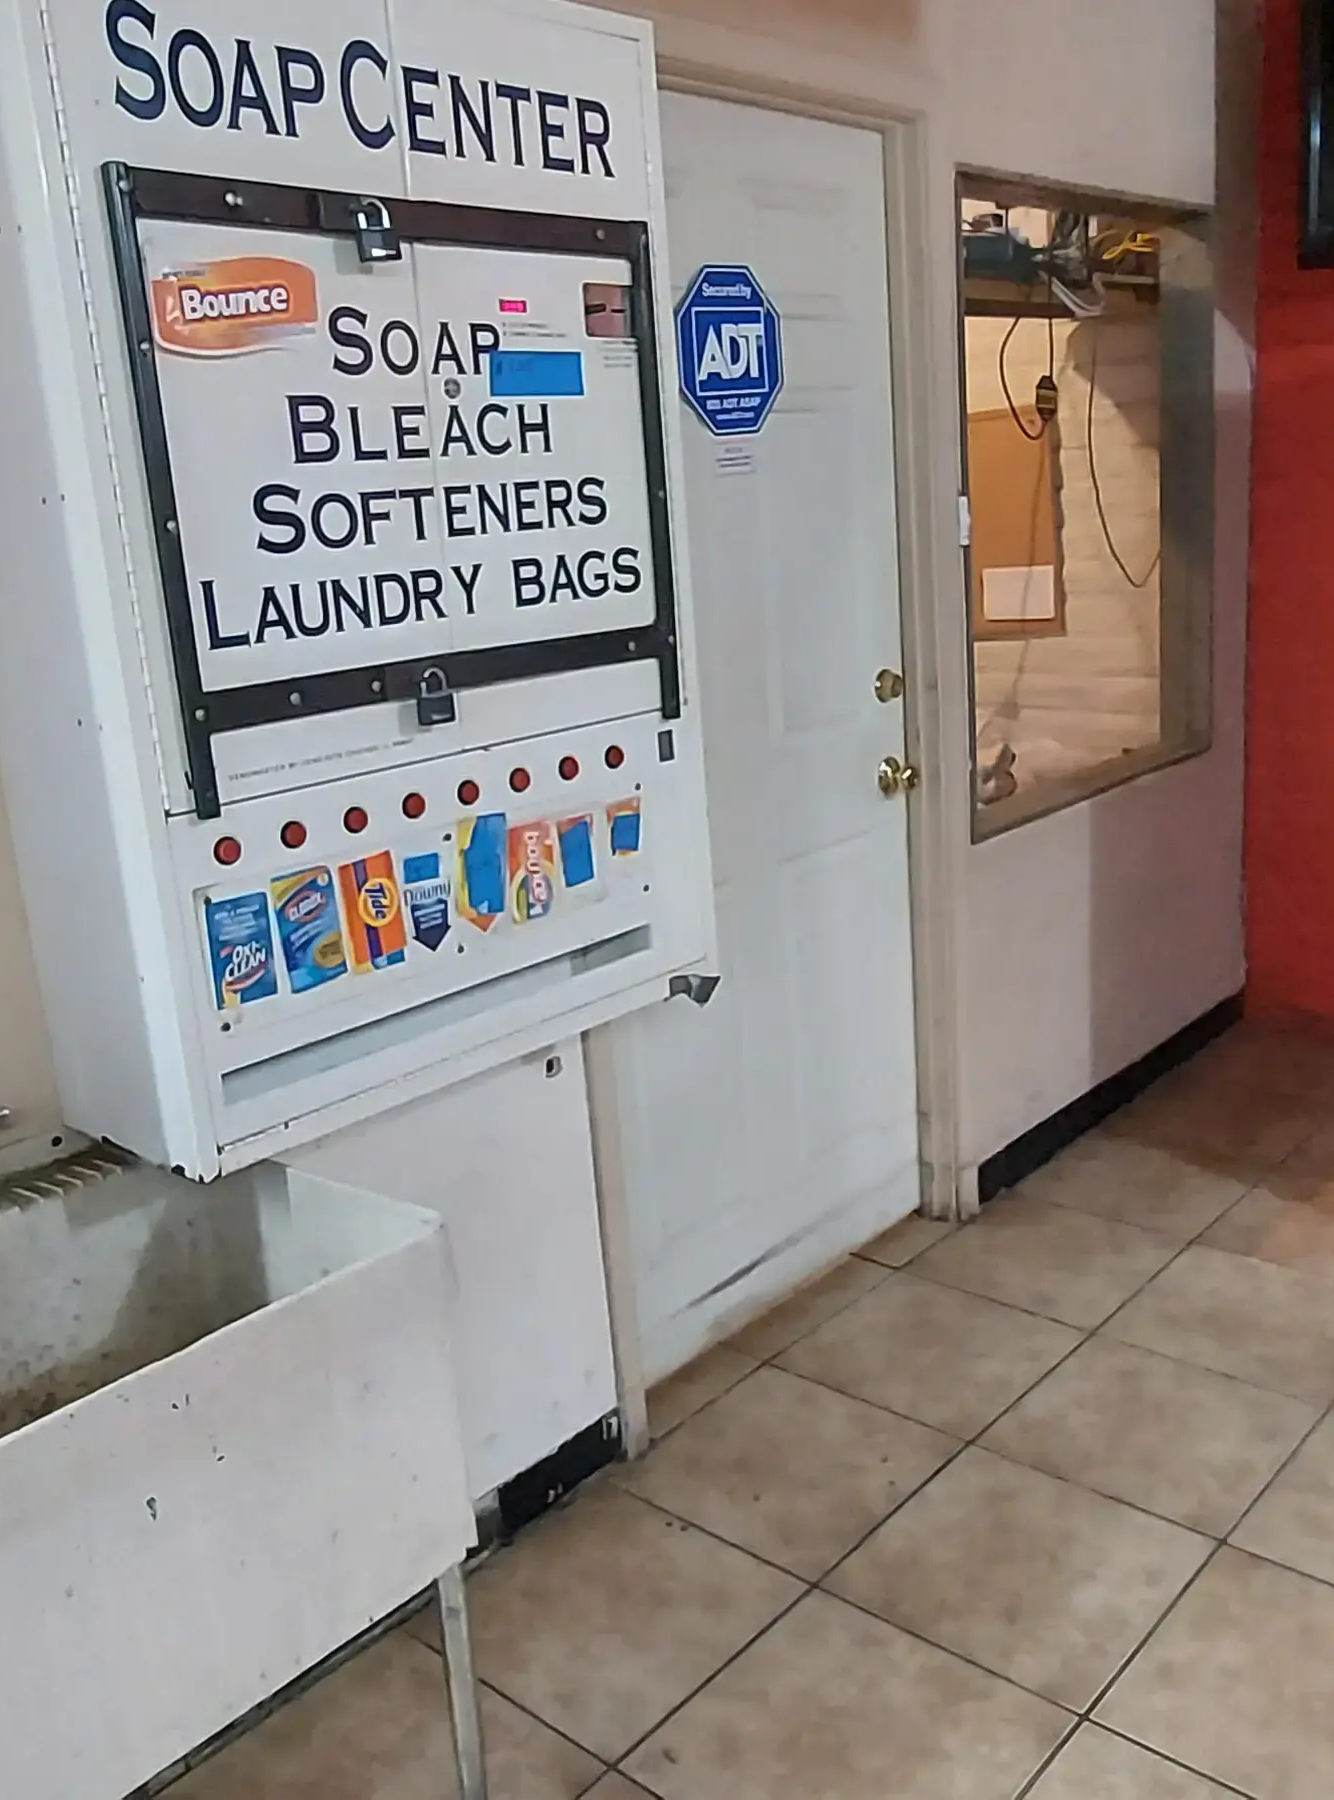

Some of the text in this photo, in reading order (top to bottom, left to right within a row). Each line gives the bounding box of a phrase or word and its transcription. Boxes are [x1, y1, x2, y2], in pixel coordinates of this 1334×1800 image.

[105, 0, 616, 178] SOAP CENTER
[180, 286, 289, 321] Bounce
[327, 306, 501, 377] SOAP
[697, 322, 764, 382] ADT
[285, 393, 553, 464] BLEACH
[252, 476, 607, 555] SOFTENERS
[200, 546, 642, 651] LAUNDRY BAGS
[364, 882, 390, 920] Tide
[403, 877, 452, 907] Downy
